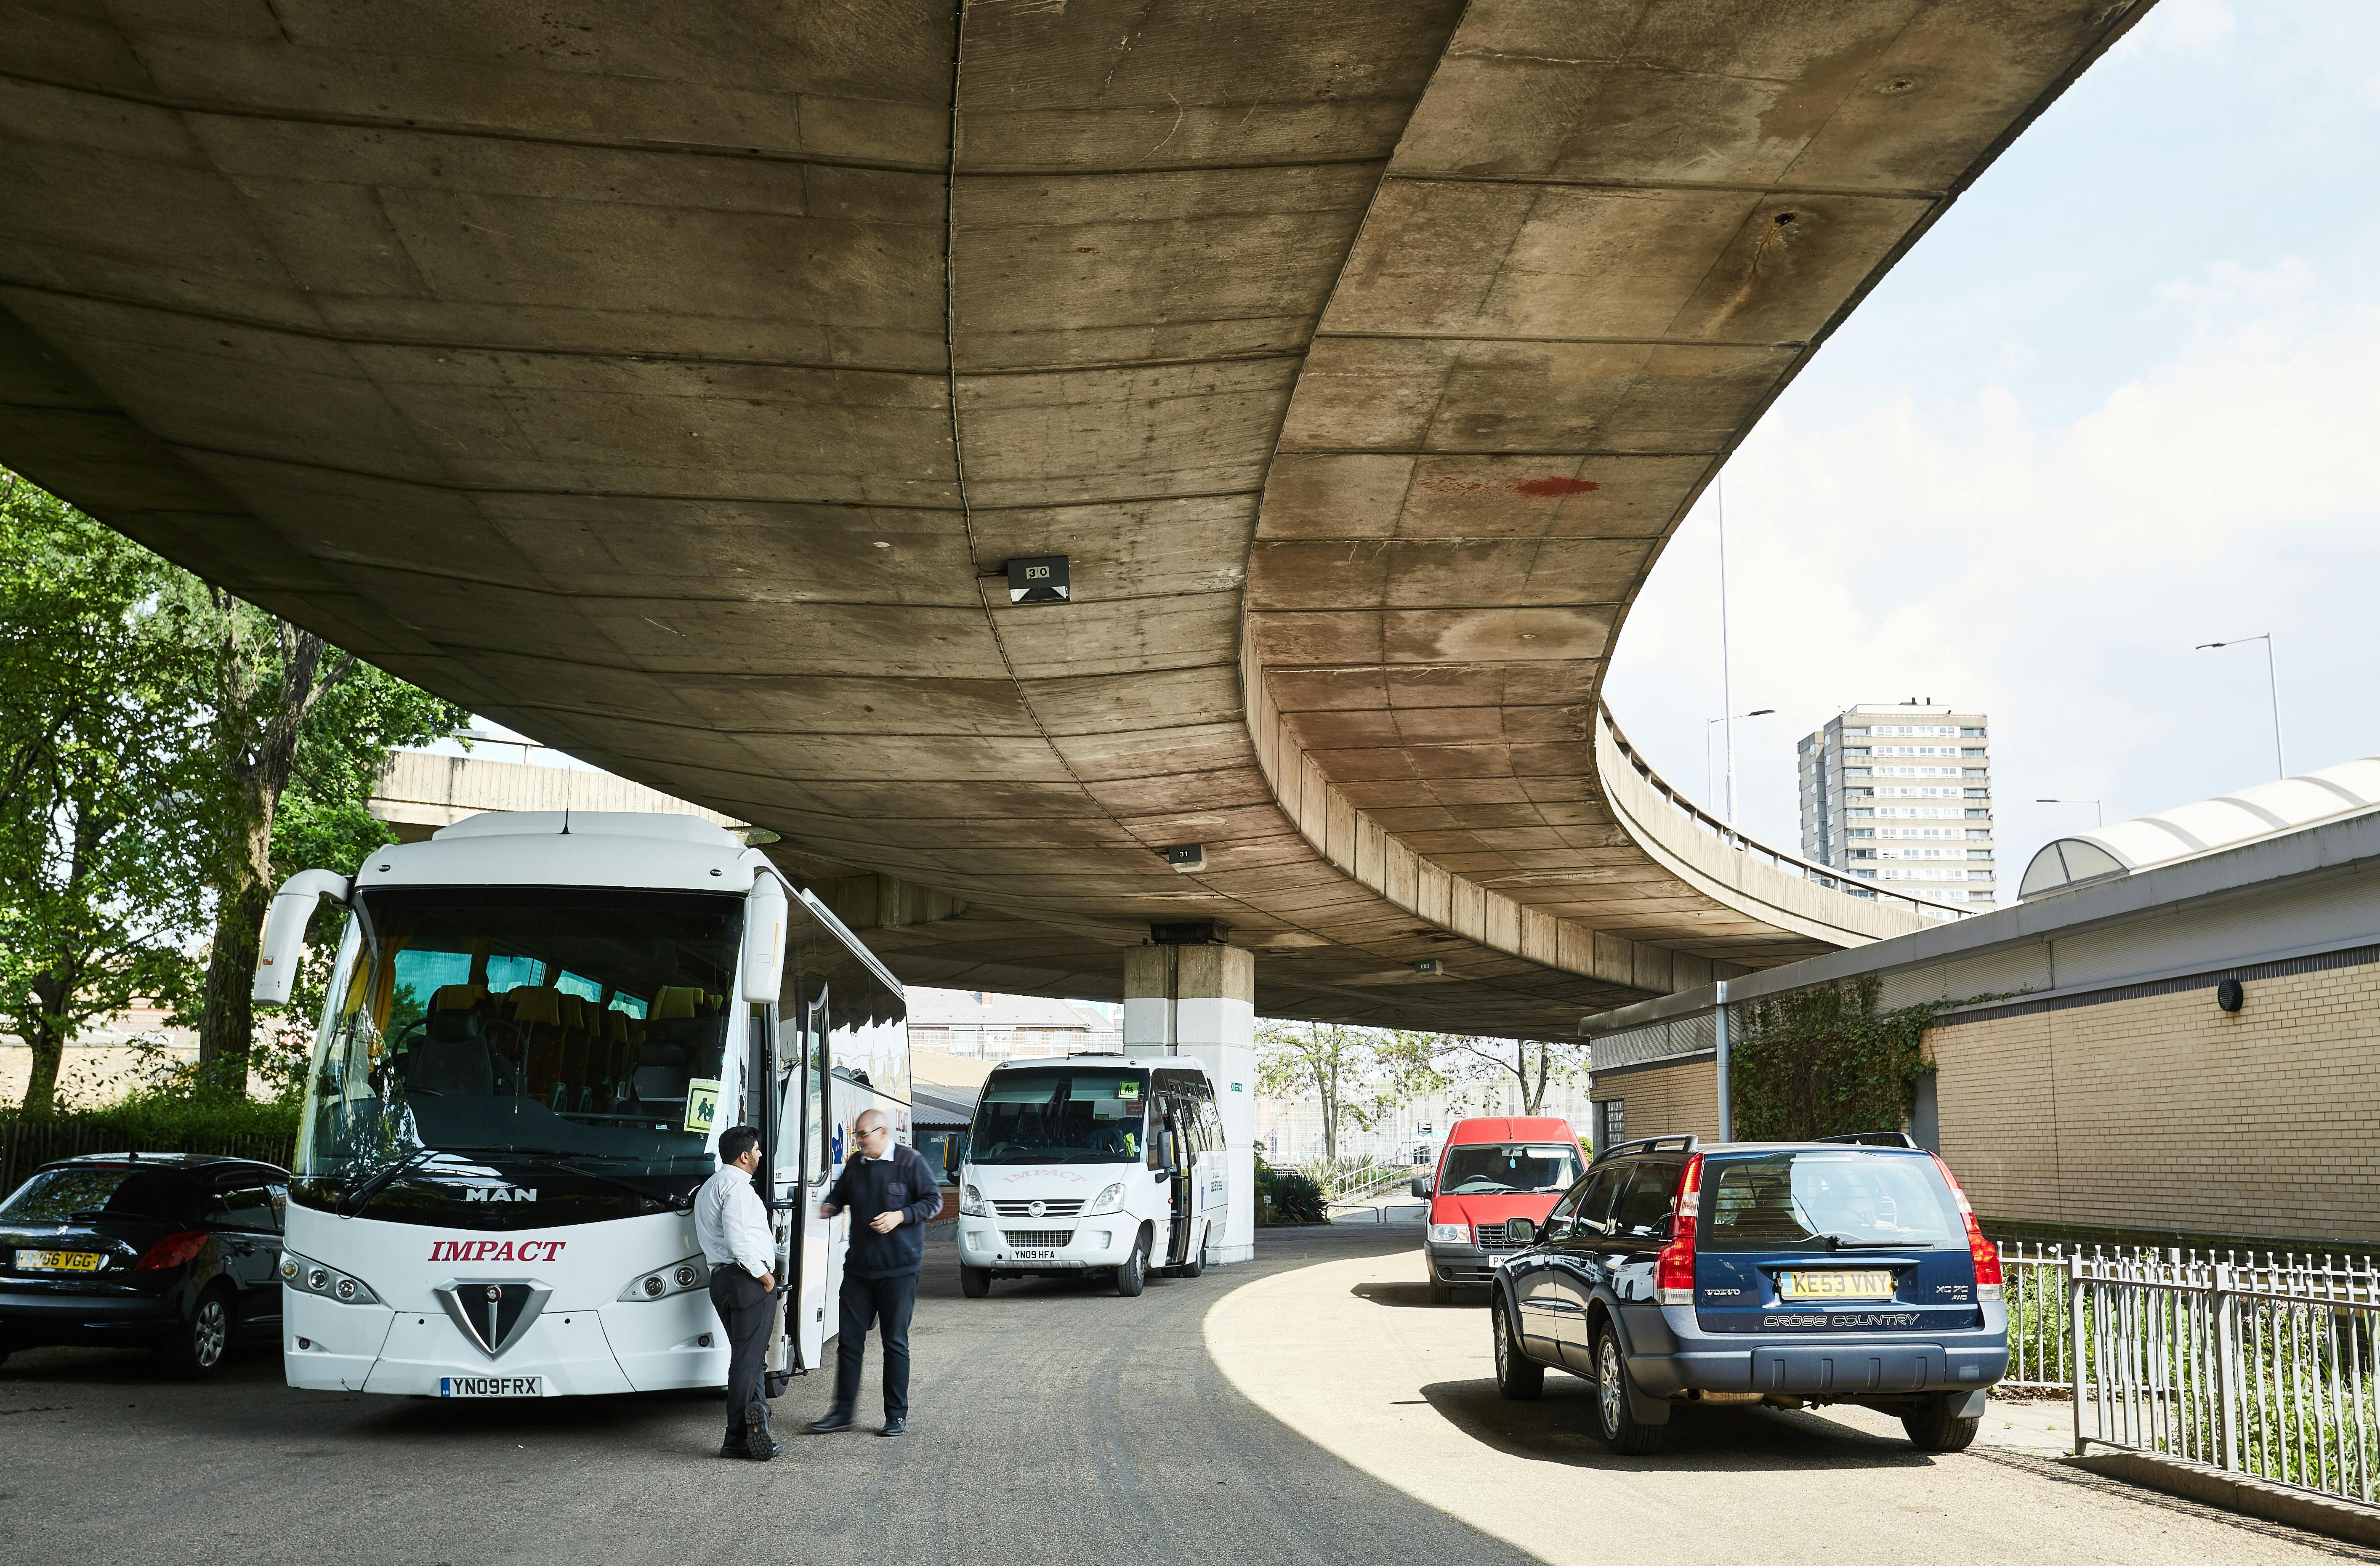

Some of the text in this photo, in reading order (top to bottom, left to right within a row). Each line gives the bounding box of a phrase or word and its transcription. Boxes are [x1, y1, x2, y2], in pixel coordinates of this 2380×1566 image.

[1029, 567, 1047, 577] 30
[1001, 1169, 1087, 1184] IMPACT
[466, 1188, 537, 1201] MAN
[428, 1241, 566, 1261] IMPACT
[65, 1254, 93, 1267] VGG
[1793, 1274, 1887, 1292] KE53 VNY
[1763, 1313, 1920, 1327] CROSS COUNTRY
[453, 1378, 536, 1395] YN09FRX
